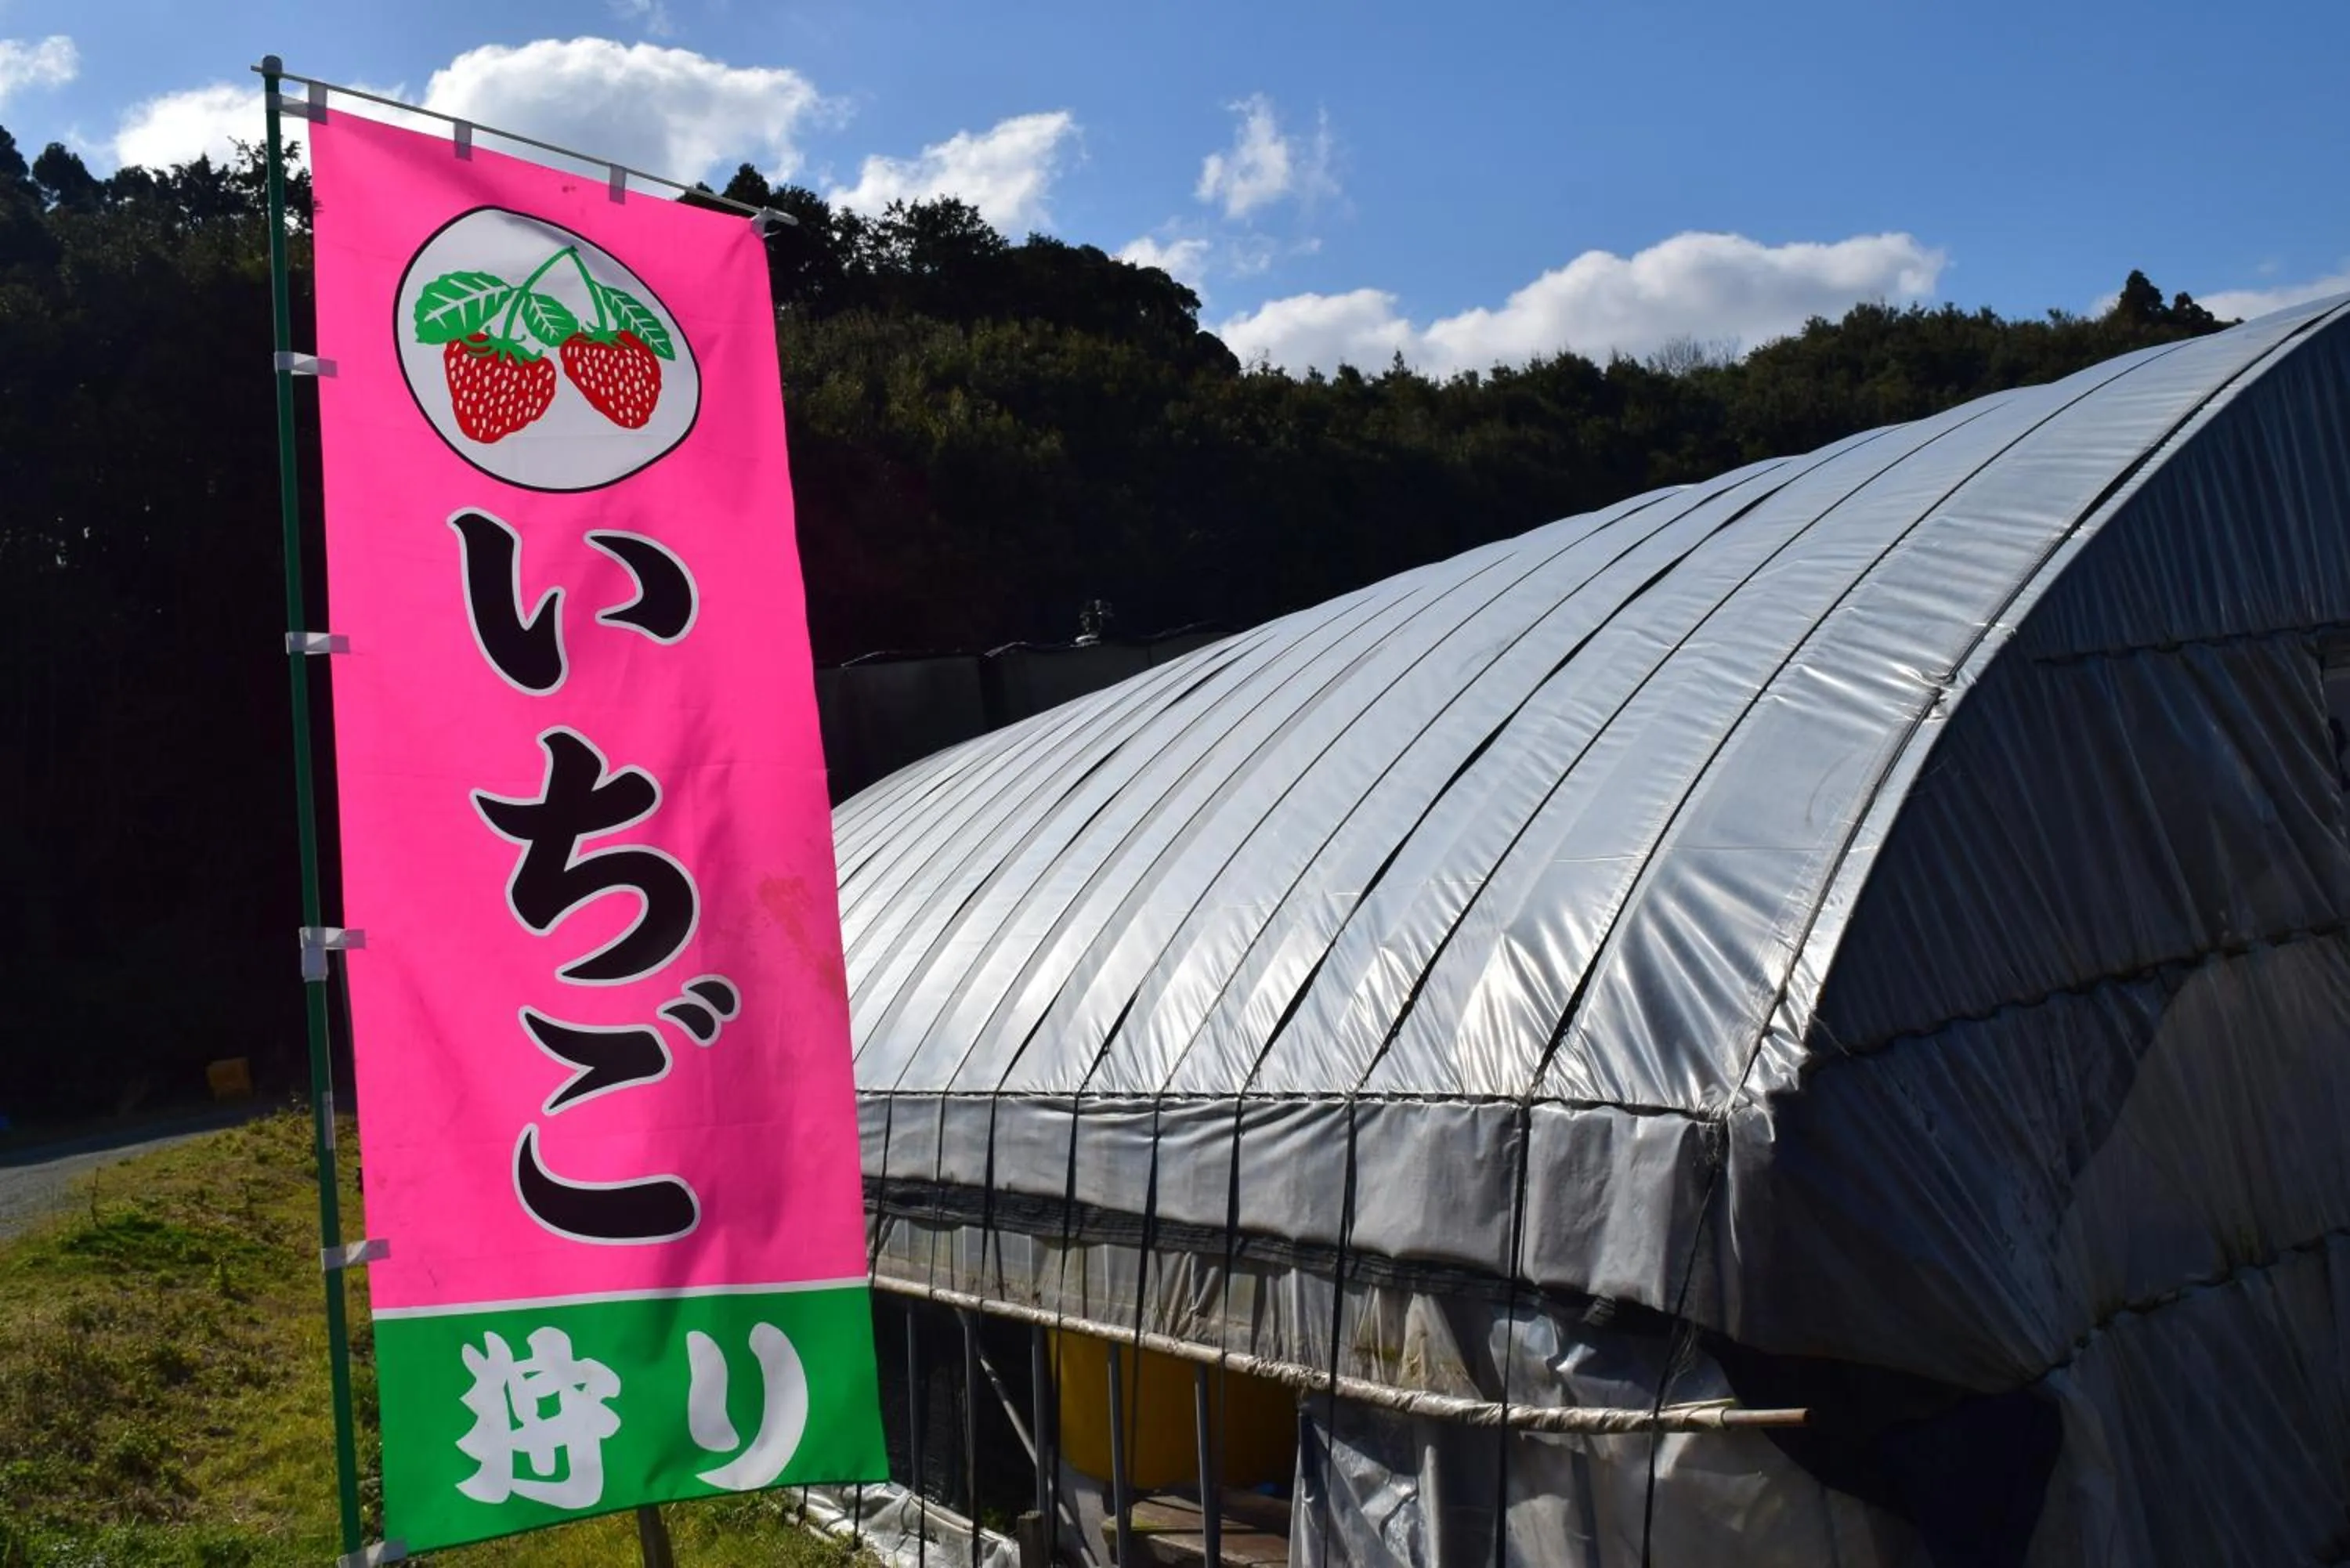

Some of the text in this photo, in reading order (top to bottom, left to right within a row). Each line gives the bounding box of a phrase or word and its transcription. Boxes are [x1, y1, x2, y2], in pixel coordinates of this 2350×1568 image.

[446, 507, 741, 1245] いちご
[455, 1321, 809, 1509] 狩り
